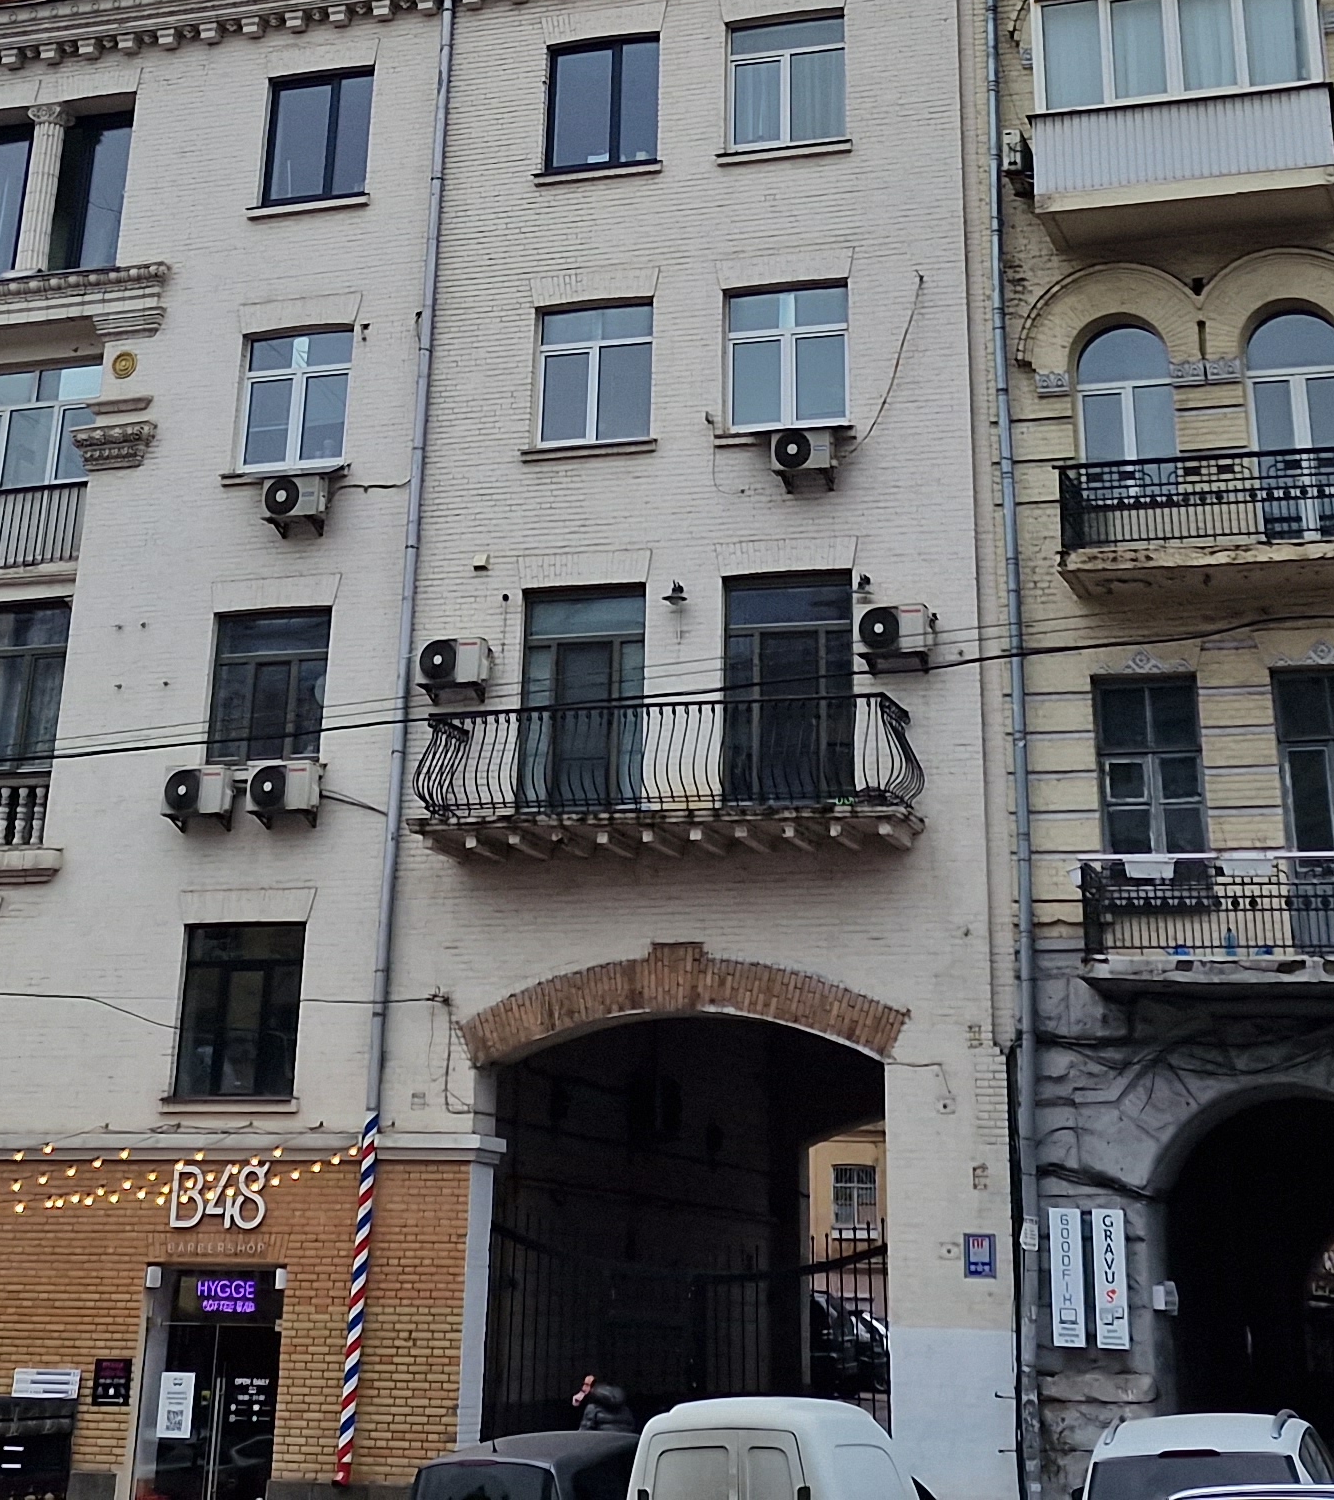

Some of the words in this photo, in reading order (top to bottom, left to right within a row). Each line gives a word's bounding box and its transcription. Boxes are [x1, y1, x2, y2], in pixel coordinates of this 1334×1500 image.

[169, 1162, 271, 1230] B48
[168, 1242, 266, 1254] BARBERSHOP
[197, 1280, 255, 1298] HYGGE
